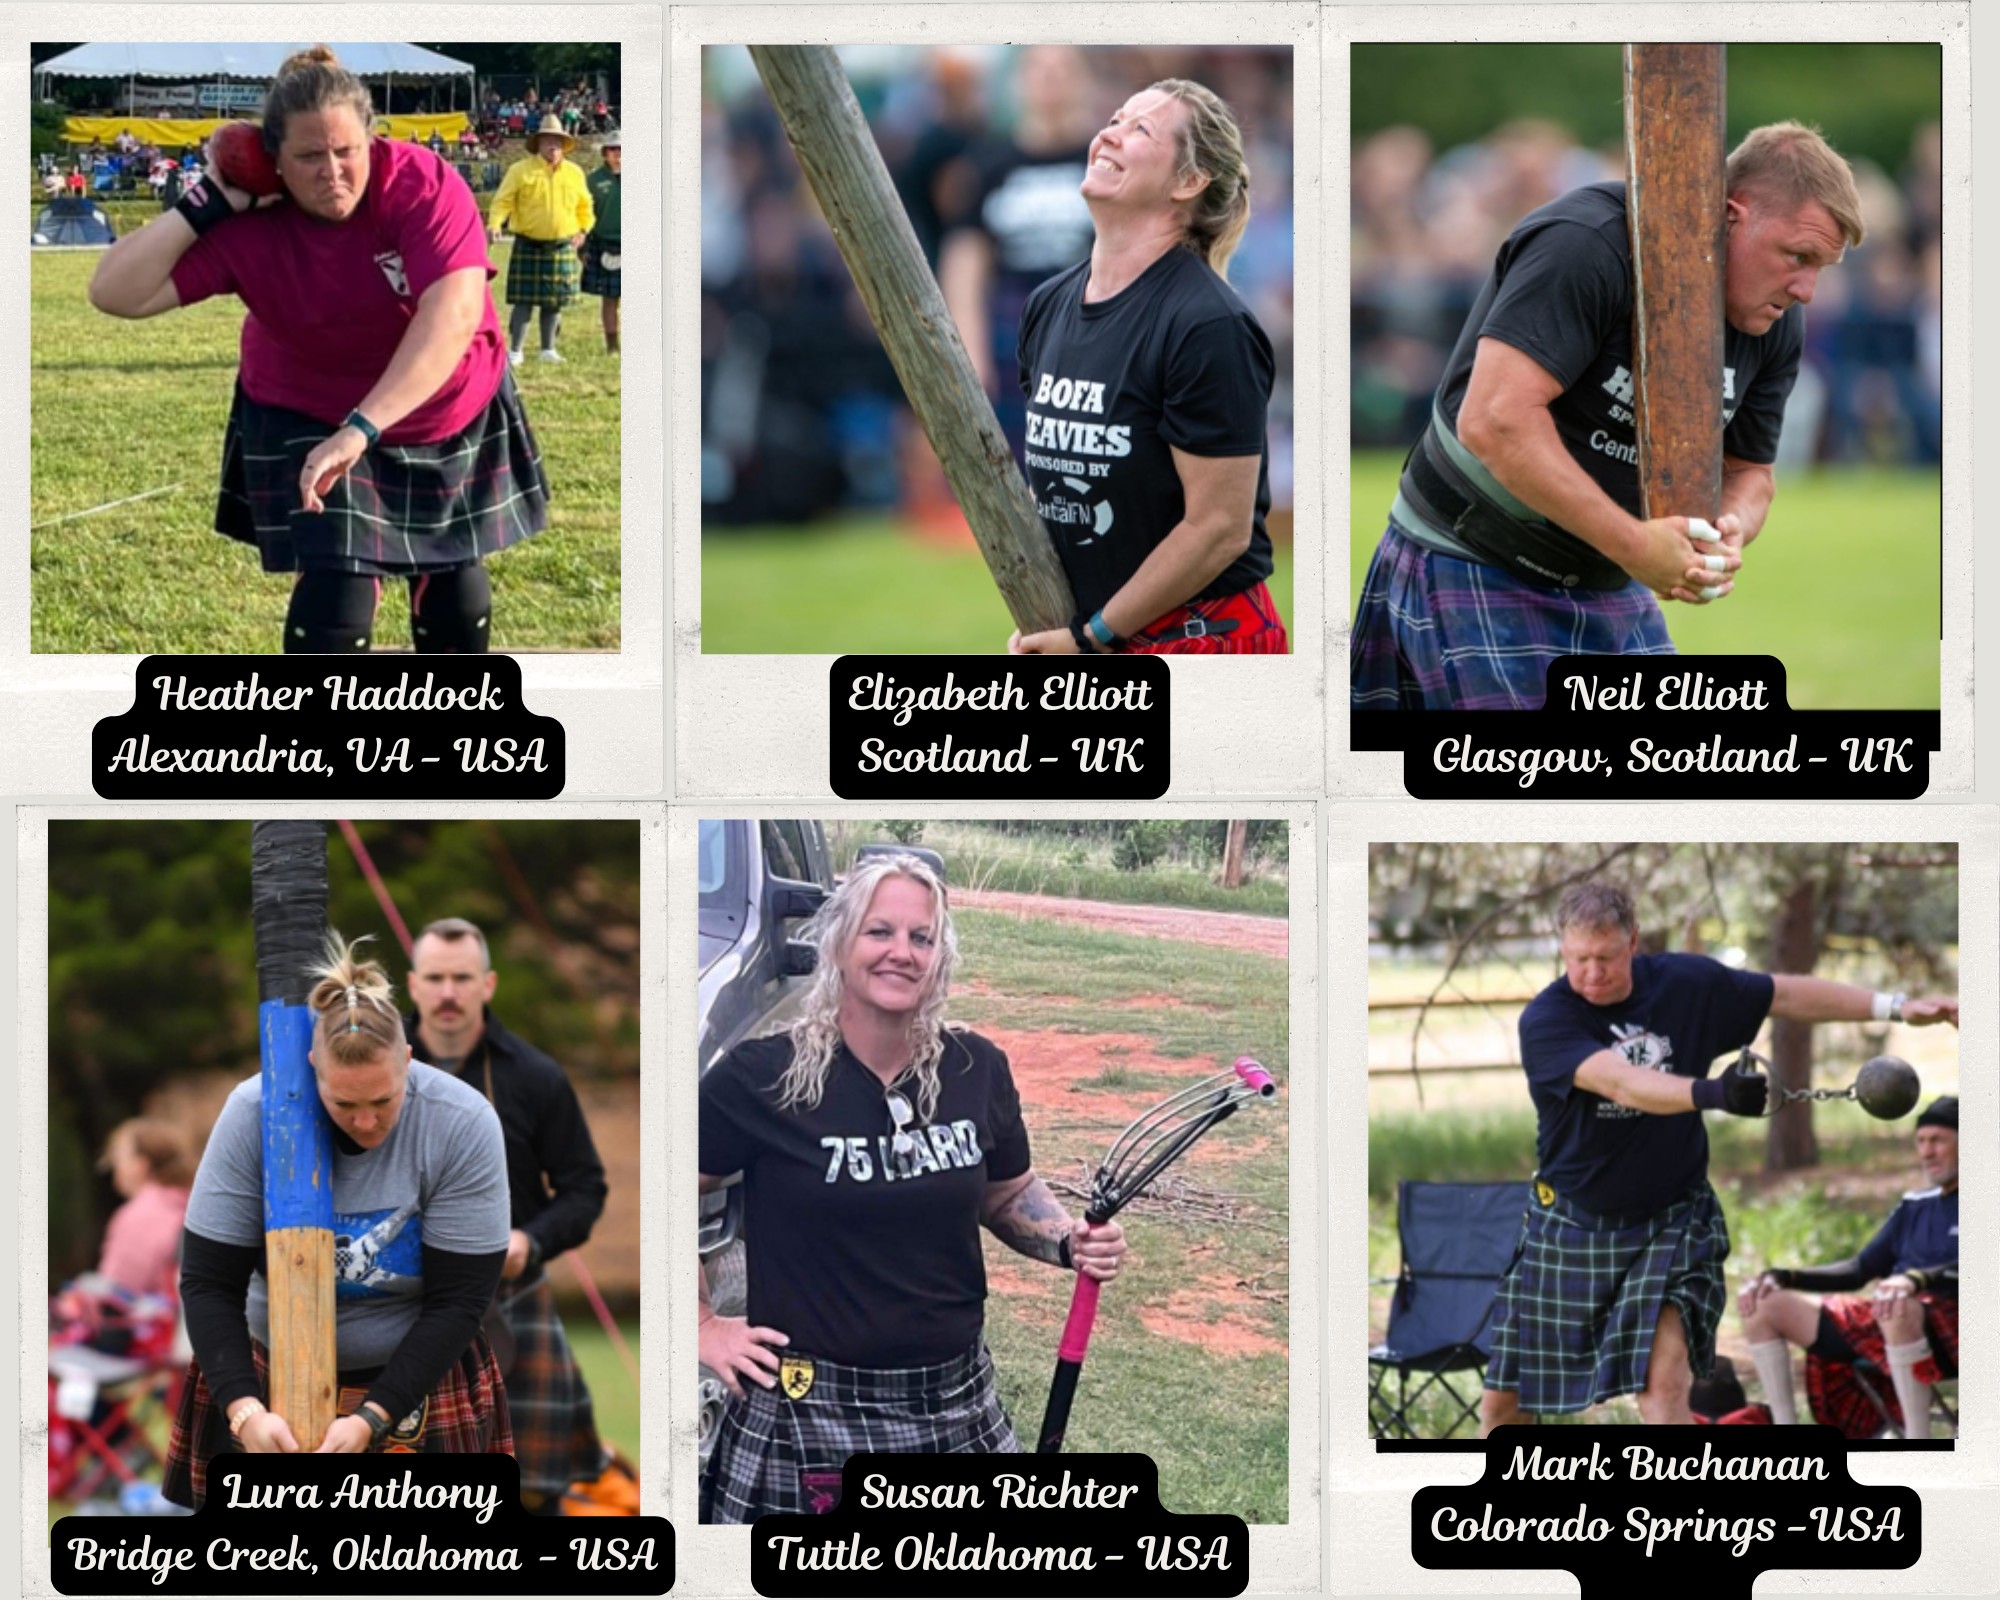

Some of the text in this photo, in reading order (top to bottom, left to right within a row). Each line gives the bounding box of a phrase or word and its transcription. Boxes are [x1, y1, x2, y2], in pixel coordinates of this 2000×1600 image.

[1034, 373, 1106, 414] BOFA
[1025, 410, 1132, 457] EAVIES
[1589, 429, 1638, 465] Cent
[1025, 450, 1111, 477] PONSORED BY
[820, 1136, 874, 1183] 75
